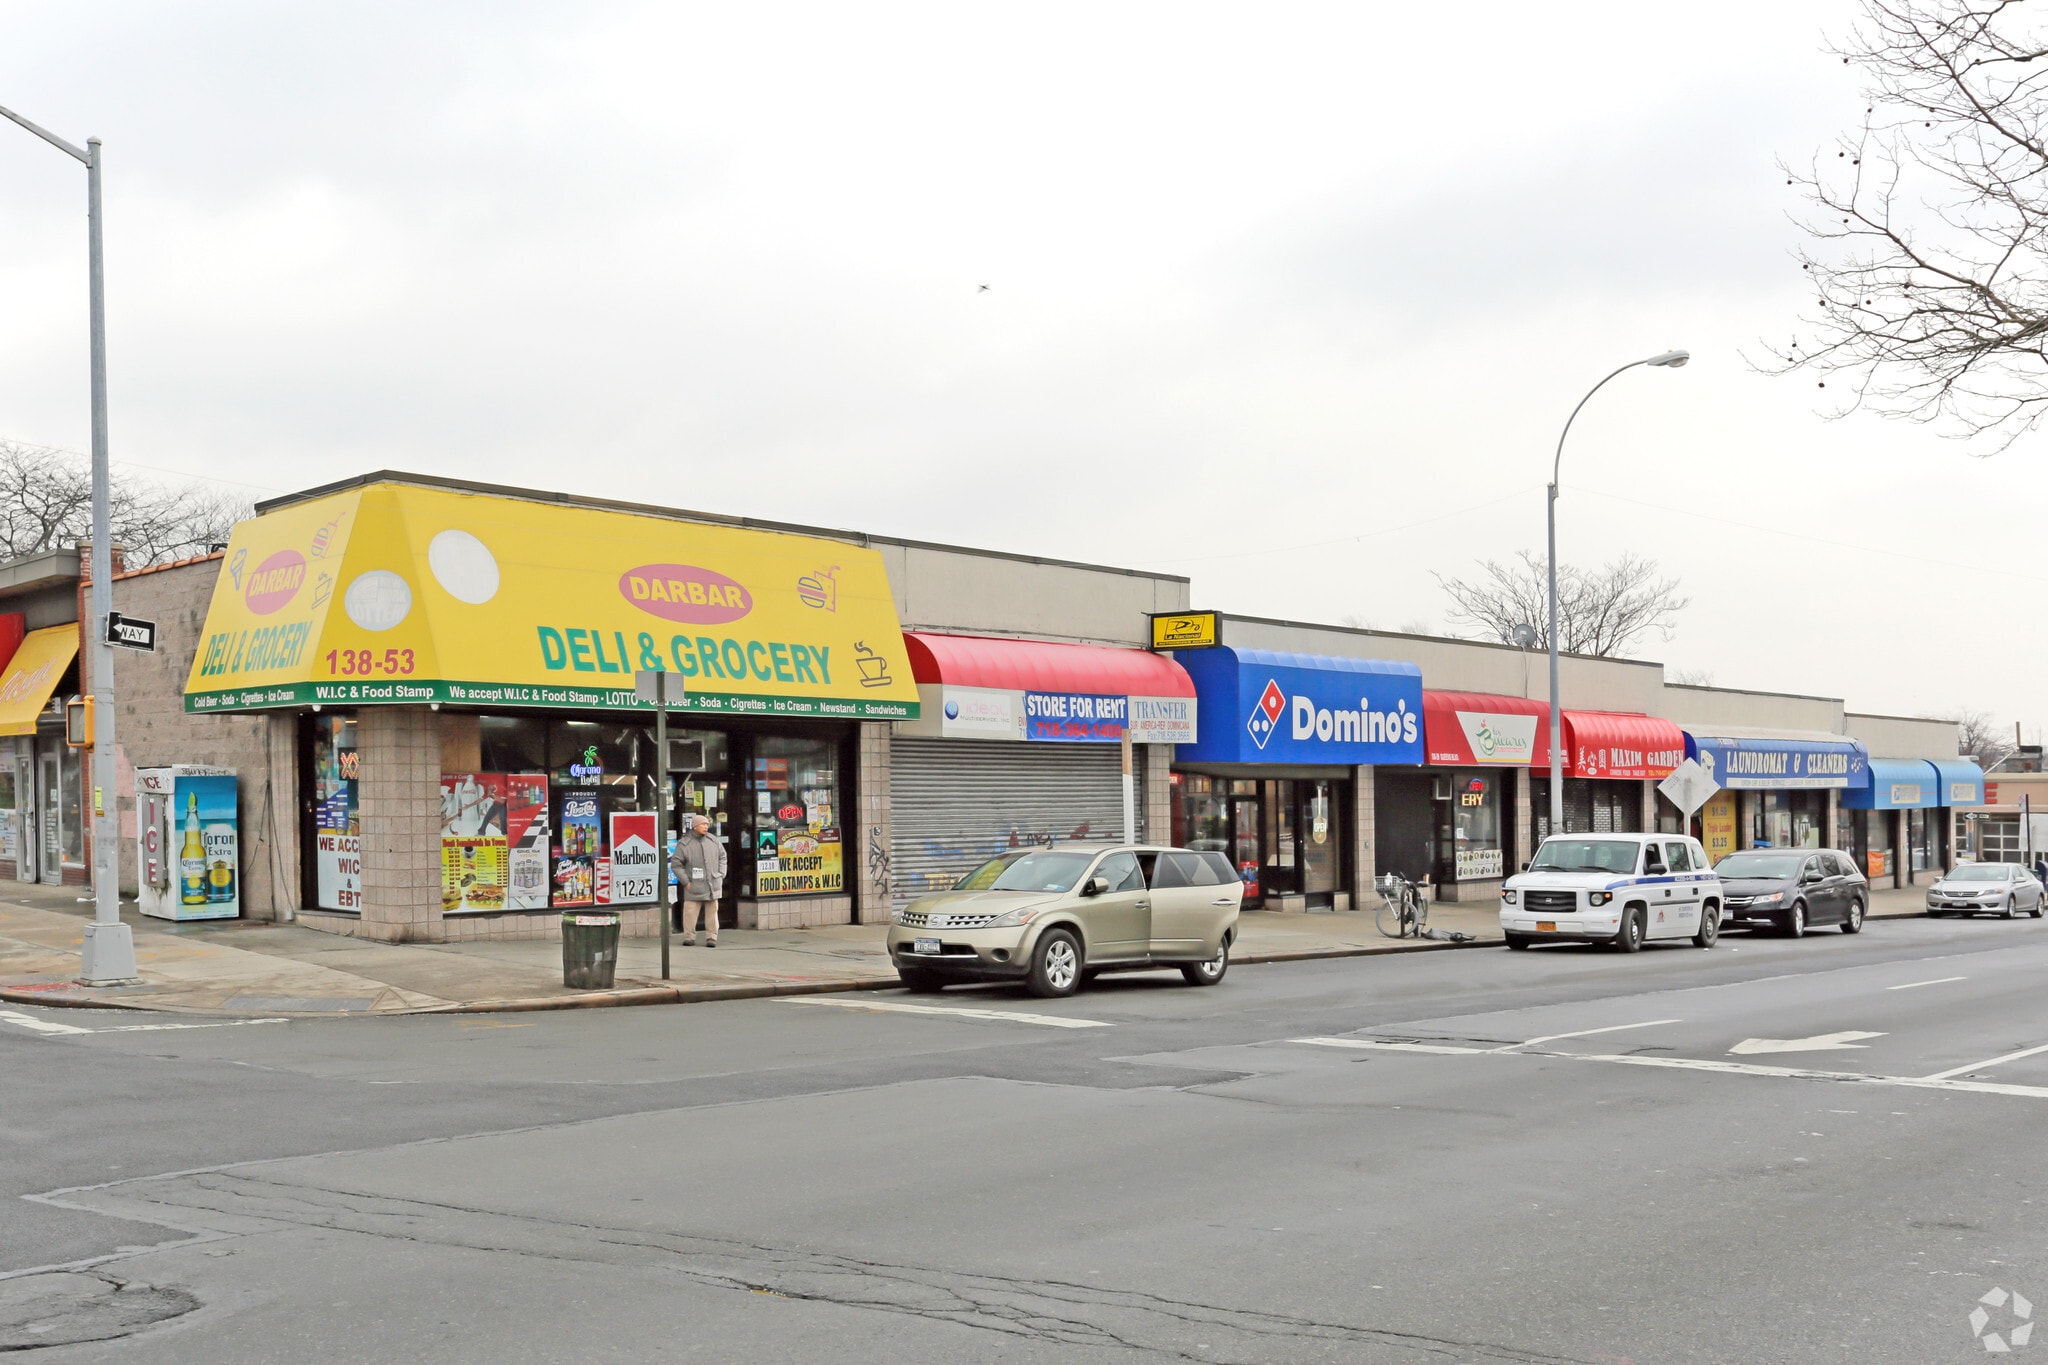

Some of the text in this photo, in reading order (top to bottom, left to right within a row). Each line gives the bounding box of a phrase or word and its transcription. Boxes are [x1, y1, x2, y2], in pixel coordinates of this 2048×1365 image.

[248, 563, 304, 599] DARBAR
[629, 576, 746, 609] DARBAR
[201, 620, 314, 677] DELI & GROCERY
[537, 625, 832, 685] DELI & GROCERY
[326, 647, 416, 676] 138-53
[194, 697, 206, 708] Cold
[206, 696, 218, 707] Beer
[222, 694, 235, 706] Soda
[268, 691, 277, 702] Ice
[276, 690, 295, 701] Cream
[316, 685, 434, 703] W.I.C & Food Stamp
[449, 686, 466, 699] We
[468, 688, 502, 702] accept
[504, 688, 530, 700] W.I.C
[532, 690, 540, 701] &
[542, 690, 567, 702] Food
[569, 691, 599, 706] Stamp
[606, 692, 639, 706] LOTTO
[700, 696, 721, 708] Soda
[730, 698, 766, 712] Cigrettes
[774, 699, 786, 711] Ice
[787, 700, 812, 712] Cream
[820, 702, 856, 714] Newstand
[865, 704, 907, 716] Sandwiches
[1027, 694, 1067, 718] STORE
[1069, 696, 1094, 719] FOR
[1095, 698, 1126, 719] RENT
[1134, 701, 1187, 720] TRANSFER
[1292, 694, 1418, 744] Domino's
[1611, 747, 1684, 768] MAXIM GARDEN
[1726, 751, 1788, 774] LAUNDROMAT
[1807, 753, 1848, 774] CLEANERS
[570, 764, 602, 777] Corona
[142, 776, 162, 789] ICE
[778, 804, 804, 820] OPEN
[319, 836, 361, 854] WE ACC
[1712, 837, 1728, 848] $3.25
[338, 857, 360, 874] WIC
[614, 846, 657, 867] Marlboro
[779, 856, 823, 872] WE ACCEPT
[347, 878, 353, 889] &
[760, 873, 841, 892] FOOD STAMPS & W.I.C
[338, 890, 361, 908] EBT
